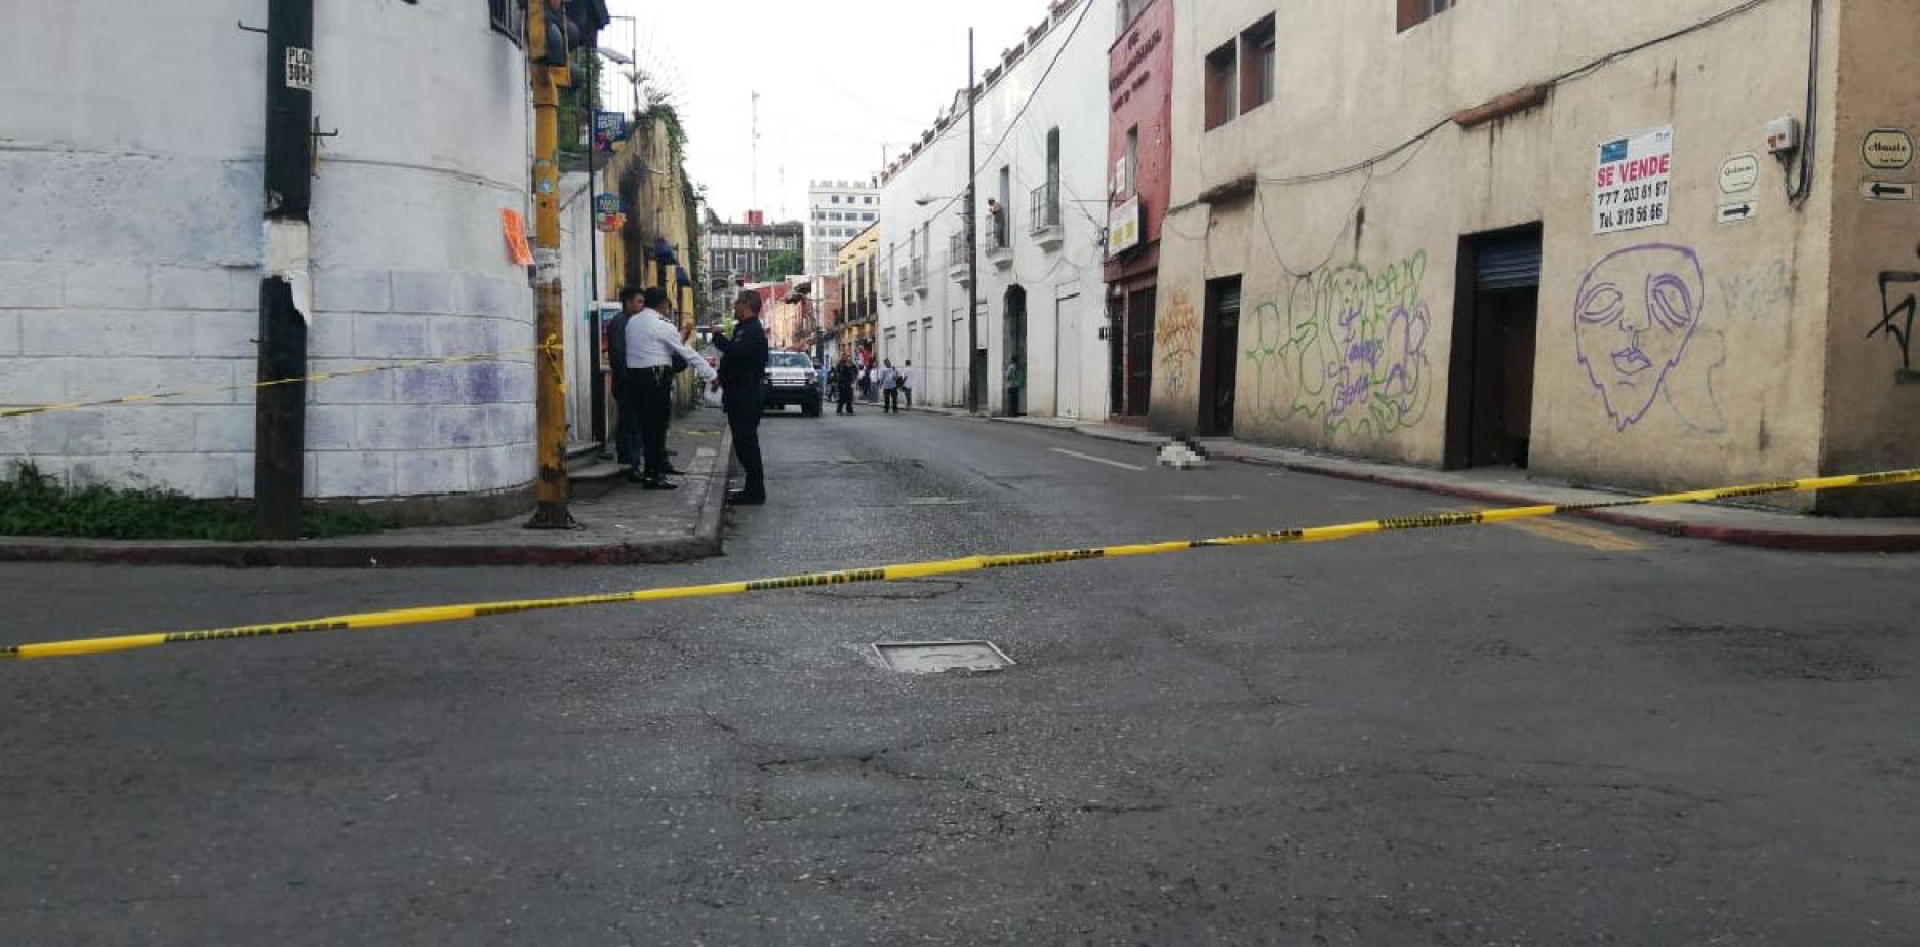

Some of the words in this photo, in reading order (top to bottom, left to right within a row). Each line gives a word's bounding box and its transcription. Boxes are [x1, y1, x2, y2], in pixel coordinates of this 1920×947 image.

[1598, 165, 1615, 187] SE
[1618, 153, 1670, 182] VENDE
[1598, 189, 1620, 206] 777
